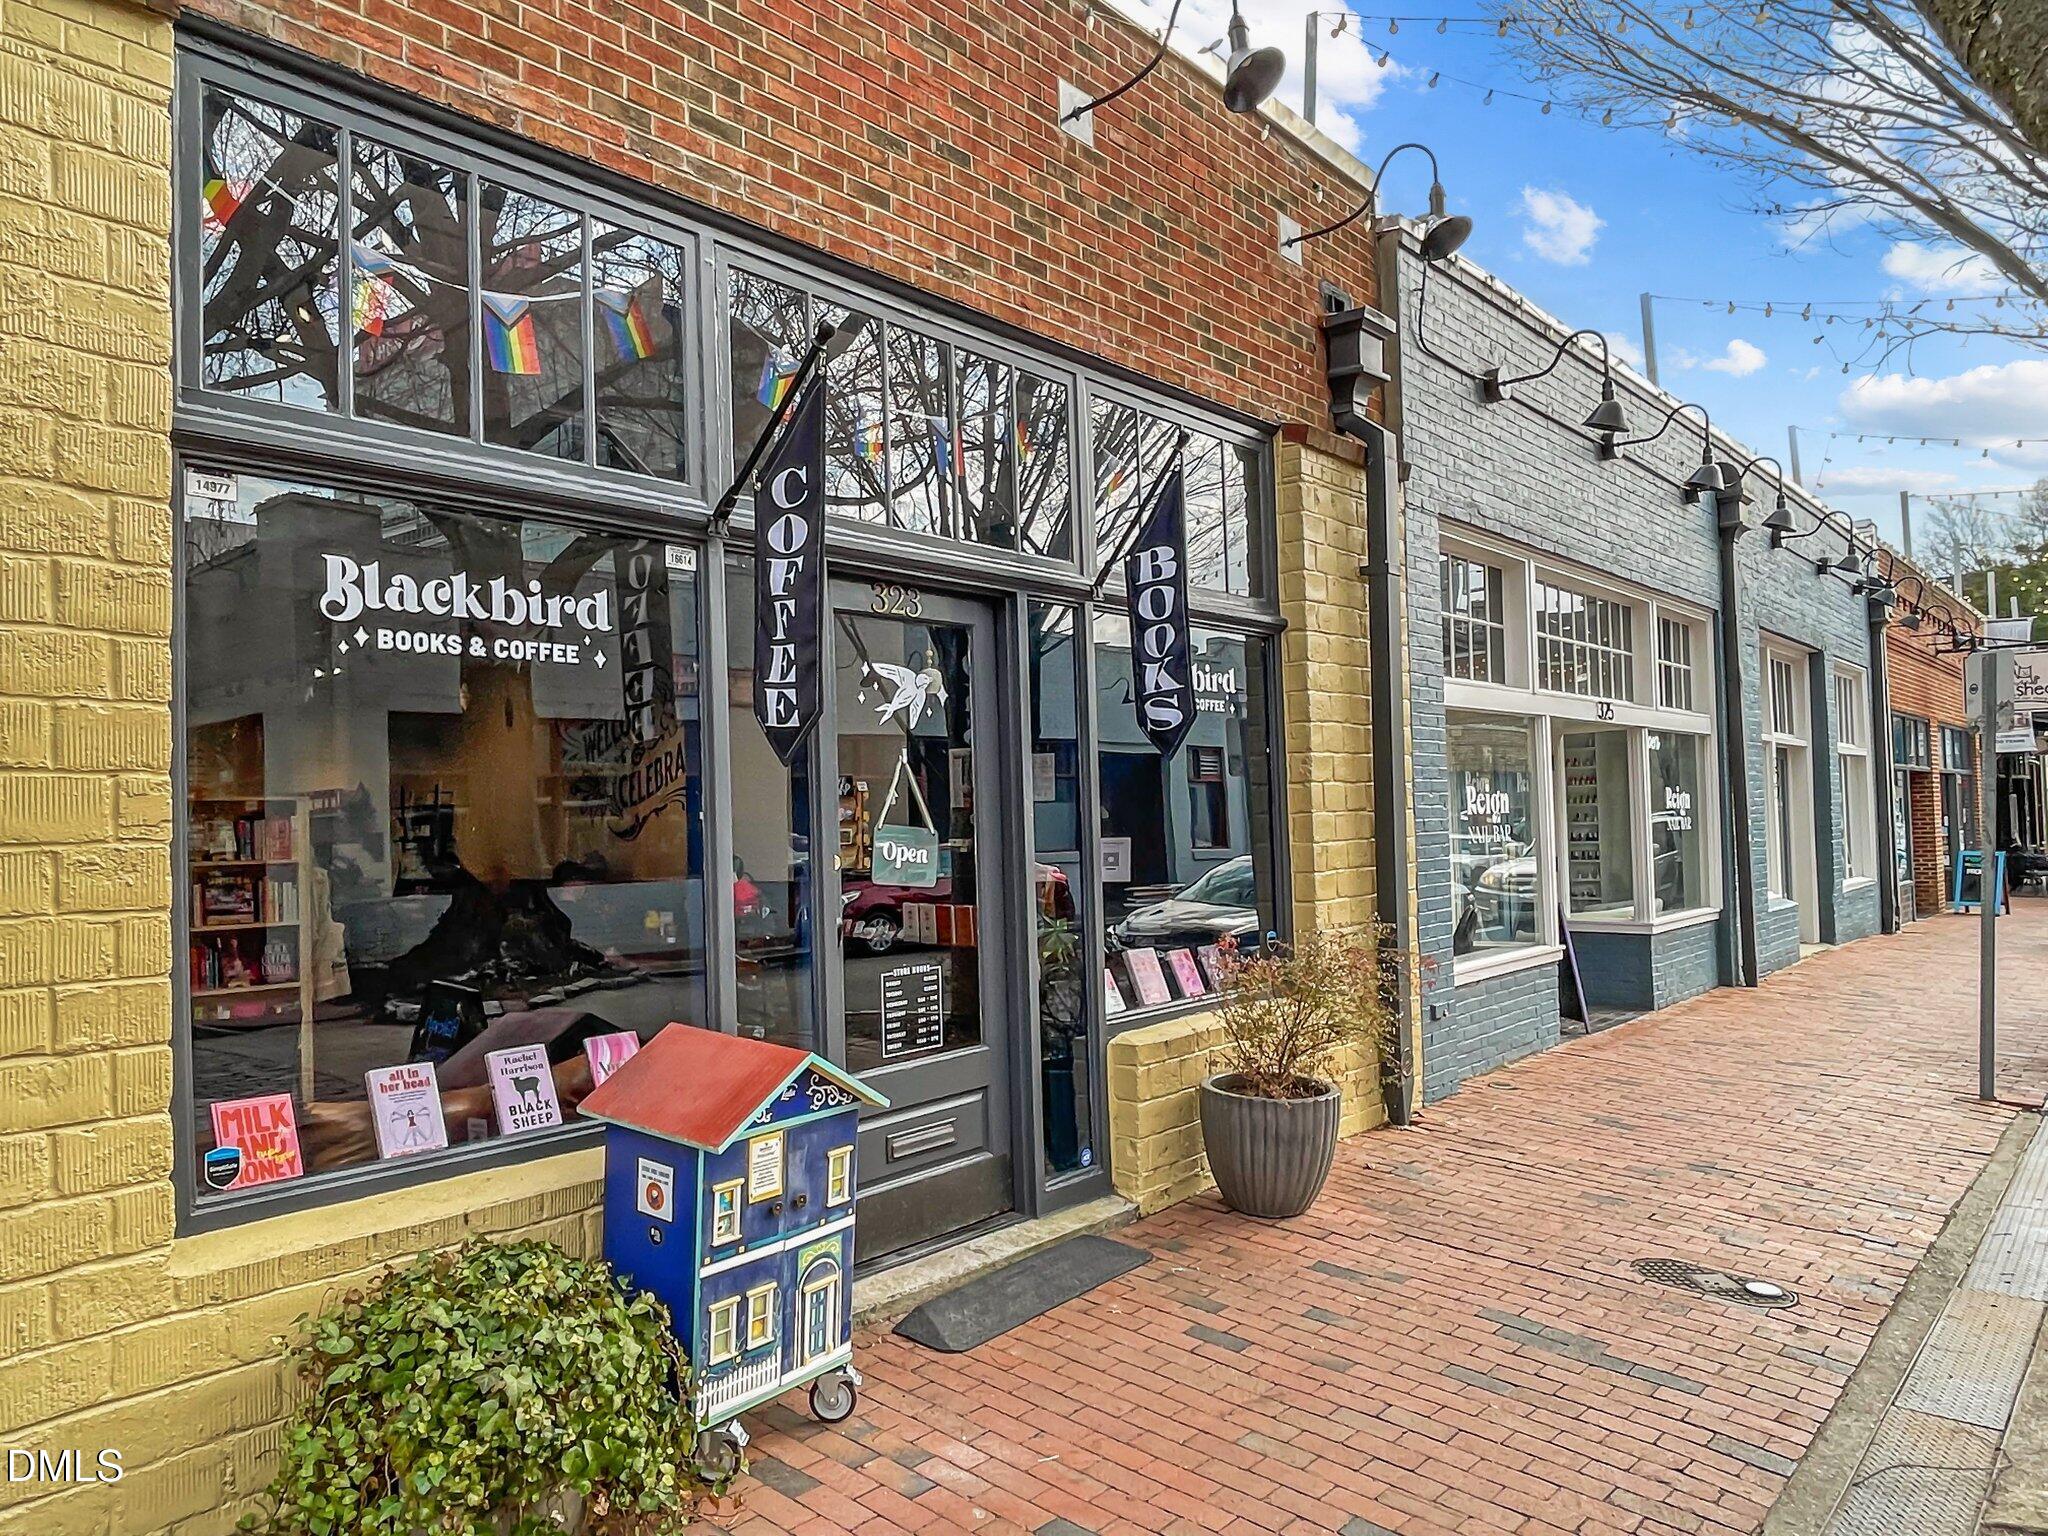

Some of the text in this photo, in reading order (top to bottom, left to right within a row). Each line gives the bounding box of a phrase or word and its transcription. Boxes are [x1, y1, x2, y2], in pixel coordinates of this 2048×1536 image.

[195, 480, 231, 494] 14977
[319, 553, 613, 632] Blackbird
[763, 465, 808, 728] COFFEE
[870, 582, 923, 618] 323
[376, 628, 580, 664] BOOKS & COFFEE
[1134, 545, 1185, 731] BOOKS
[1466, 783, 1510, 823] Reign
[1665, 785, 1691, 817] Reign
[1493, 823, 1512, 843] BAR
[882, 840, 929, 869] Open
[389, 1069, 405, 1081] all
[220, 1102, 291, 1138] MILK
[508, 1098, 553, 1117] BLACK
[512, 1111, 553, 1130] SHEEP
[237, 1131, 287, 1161] AND
